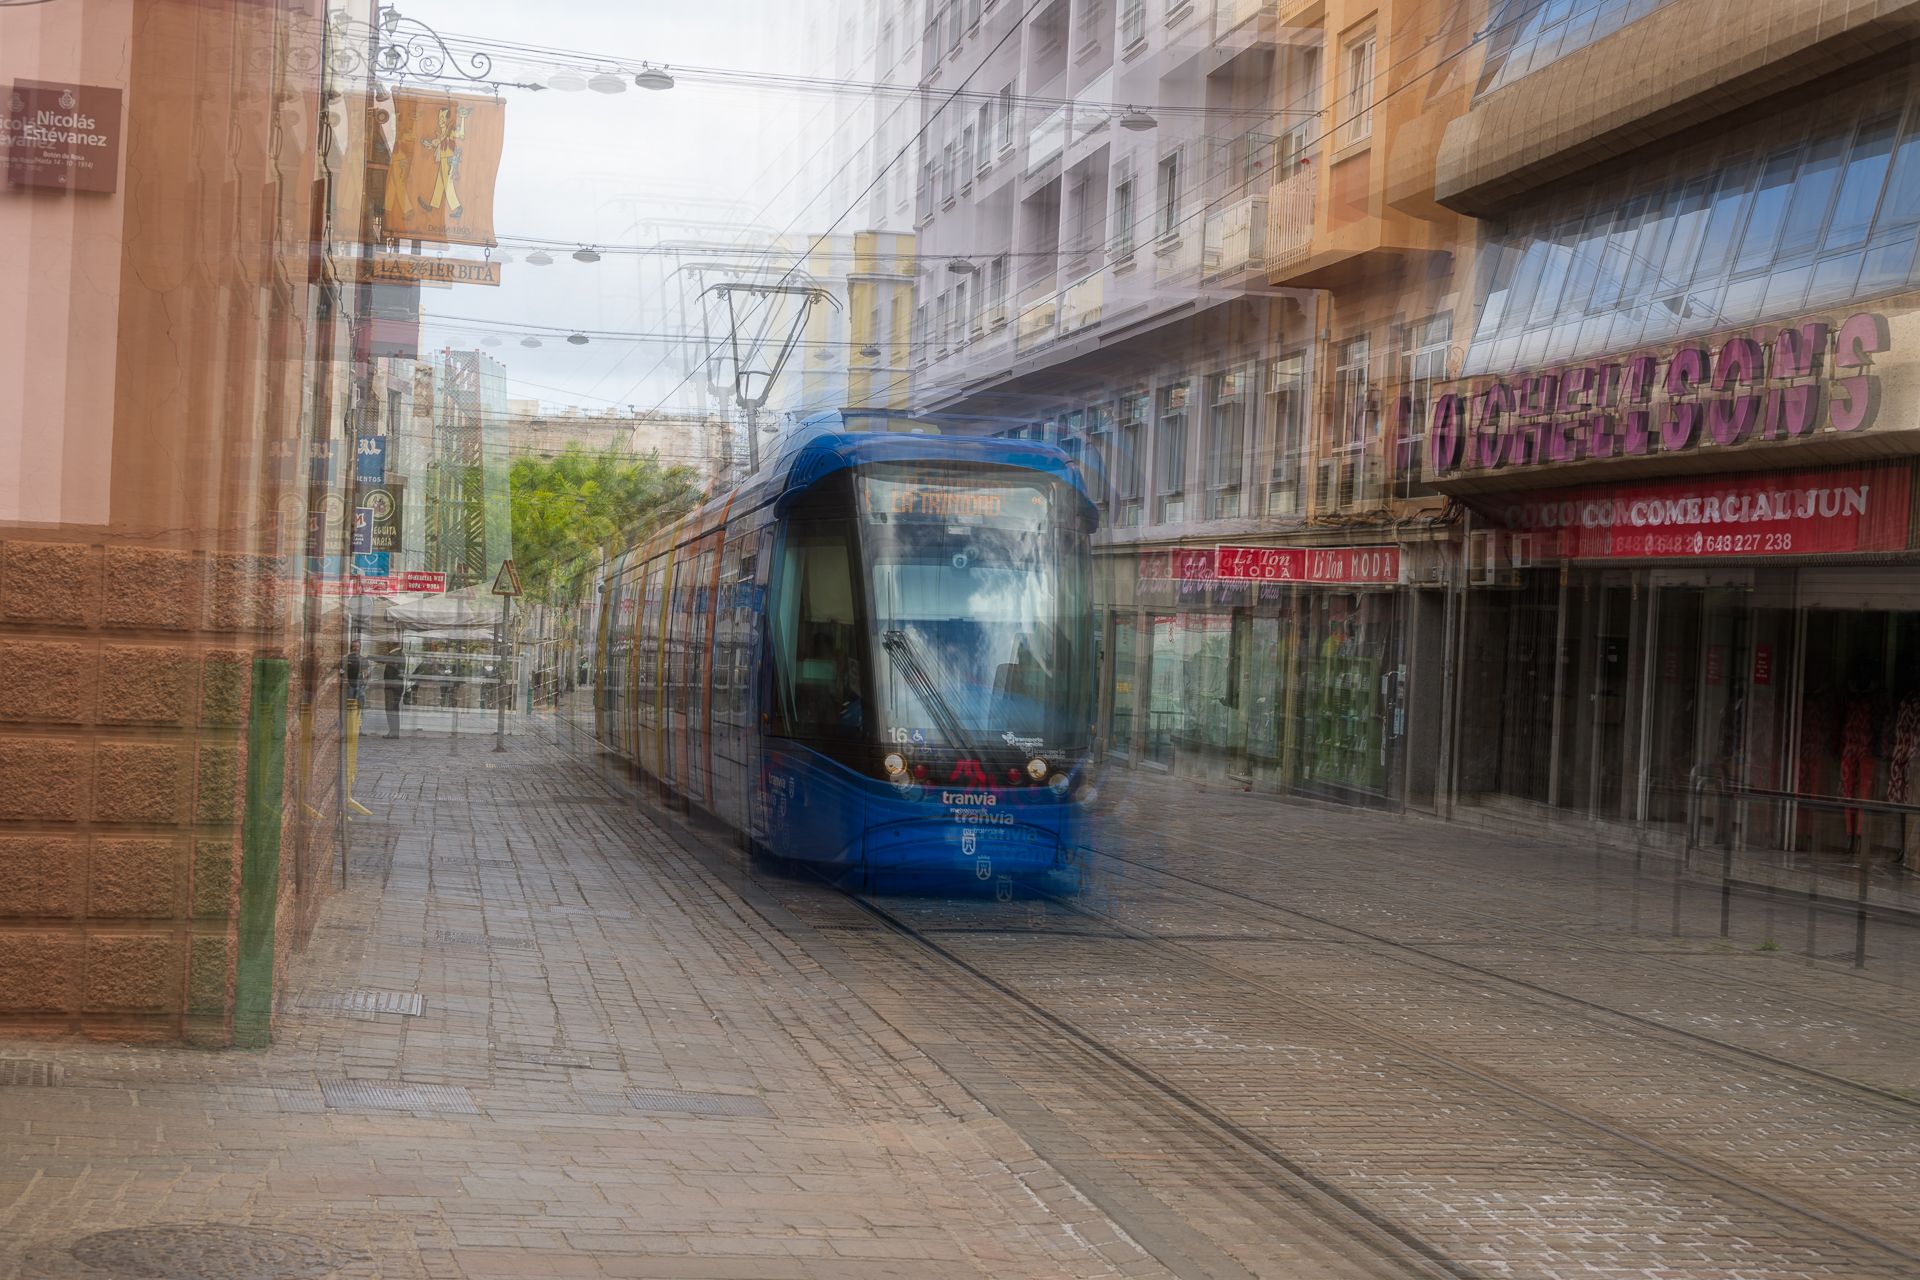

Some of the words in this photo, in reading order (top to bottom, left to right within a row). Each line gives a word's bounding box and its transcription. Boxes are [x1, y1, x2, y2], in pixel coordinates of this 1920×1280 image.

[37, 110, 96, 130] Nicolás
[23, 124, 107, 147] Estévanez
[381, 259, 402, 274] LA
[1630, 490, 1793, 527] COMERCIAL
[1797, 485, 1870, 519] JUN
[373, 526, 397, 536] EGUITA
[372, 537, 392, 546] NARIA
[1734, 534, 1760, 551] 227
[1765, 532, 1792, 550] 238
[1233, 549, 1253, 565] Li
[1260, 549, 1291, 566] Ton
[1351, 551, 1391, 577] MODA
[1234, 566, 1291, 578] MODA
[888, 727, 908, 743] 16
